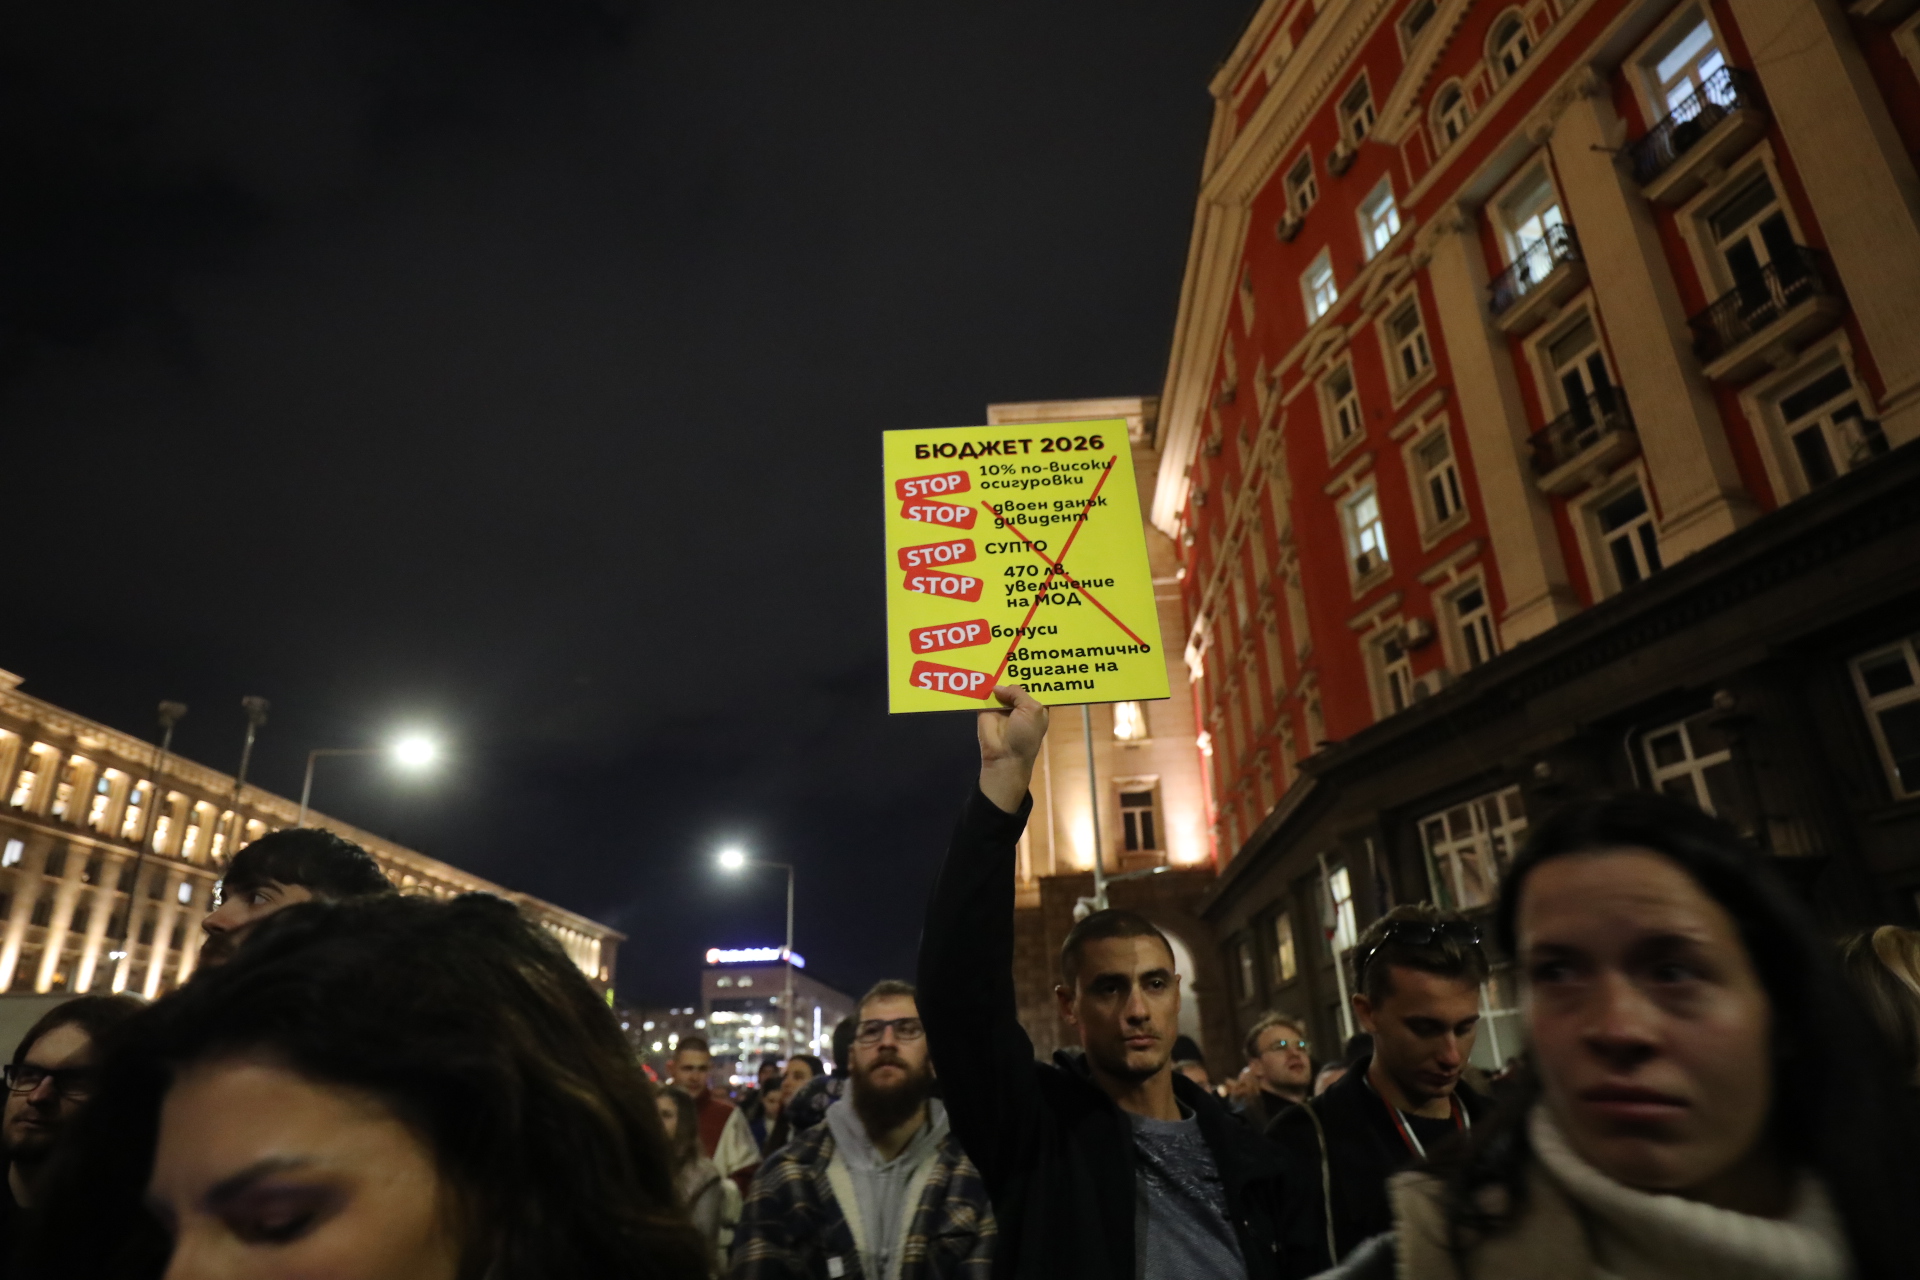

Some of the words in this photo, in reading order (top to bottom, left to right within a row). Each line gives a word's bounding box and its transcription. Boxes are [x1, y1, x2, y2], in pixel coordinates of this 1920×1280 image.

[915, 439, 1033, 459] БЮДЖЕТ
[1040, 434, 1105, 453] 2026
[979, 464, 1016, 475] 10%
[1021, 459, 1113, 474] по-високи
[903, 474, 961, 497] STOP
[980, 475, 1084, 490] осигуровки
[908, 505, 970, 523] STOP
[993, 500, 1048, 514] двоен
[1054, 496, 1107, 512] данък
[994, 512, 1089, 529] дивидент
[906, 543, 966, 567] STOP
[985, 540, 1047, 554] СУПТО
[1004, 565, 1039, 577] 470
[911, 577, 976, 594] STOP
[1005, 577, 1115, 596] увеличение
[1007, 597, 1030, 608] на
[1034, 592, 1081, 607] МОД
[918, 624, 981, 650] STOP
[991, 624, 1058, 640] бонуси
[1006, 644, 1151, 662] автоматично
[1007, 664, 1089, 681] вдигане
[1095, 661, 1119, 673] на
[918, 672, 986, 691] STOP
[1018, 679, 1095, 693] аплати
